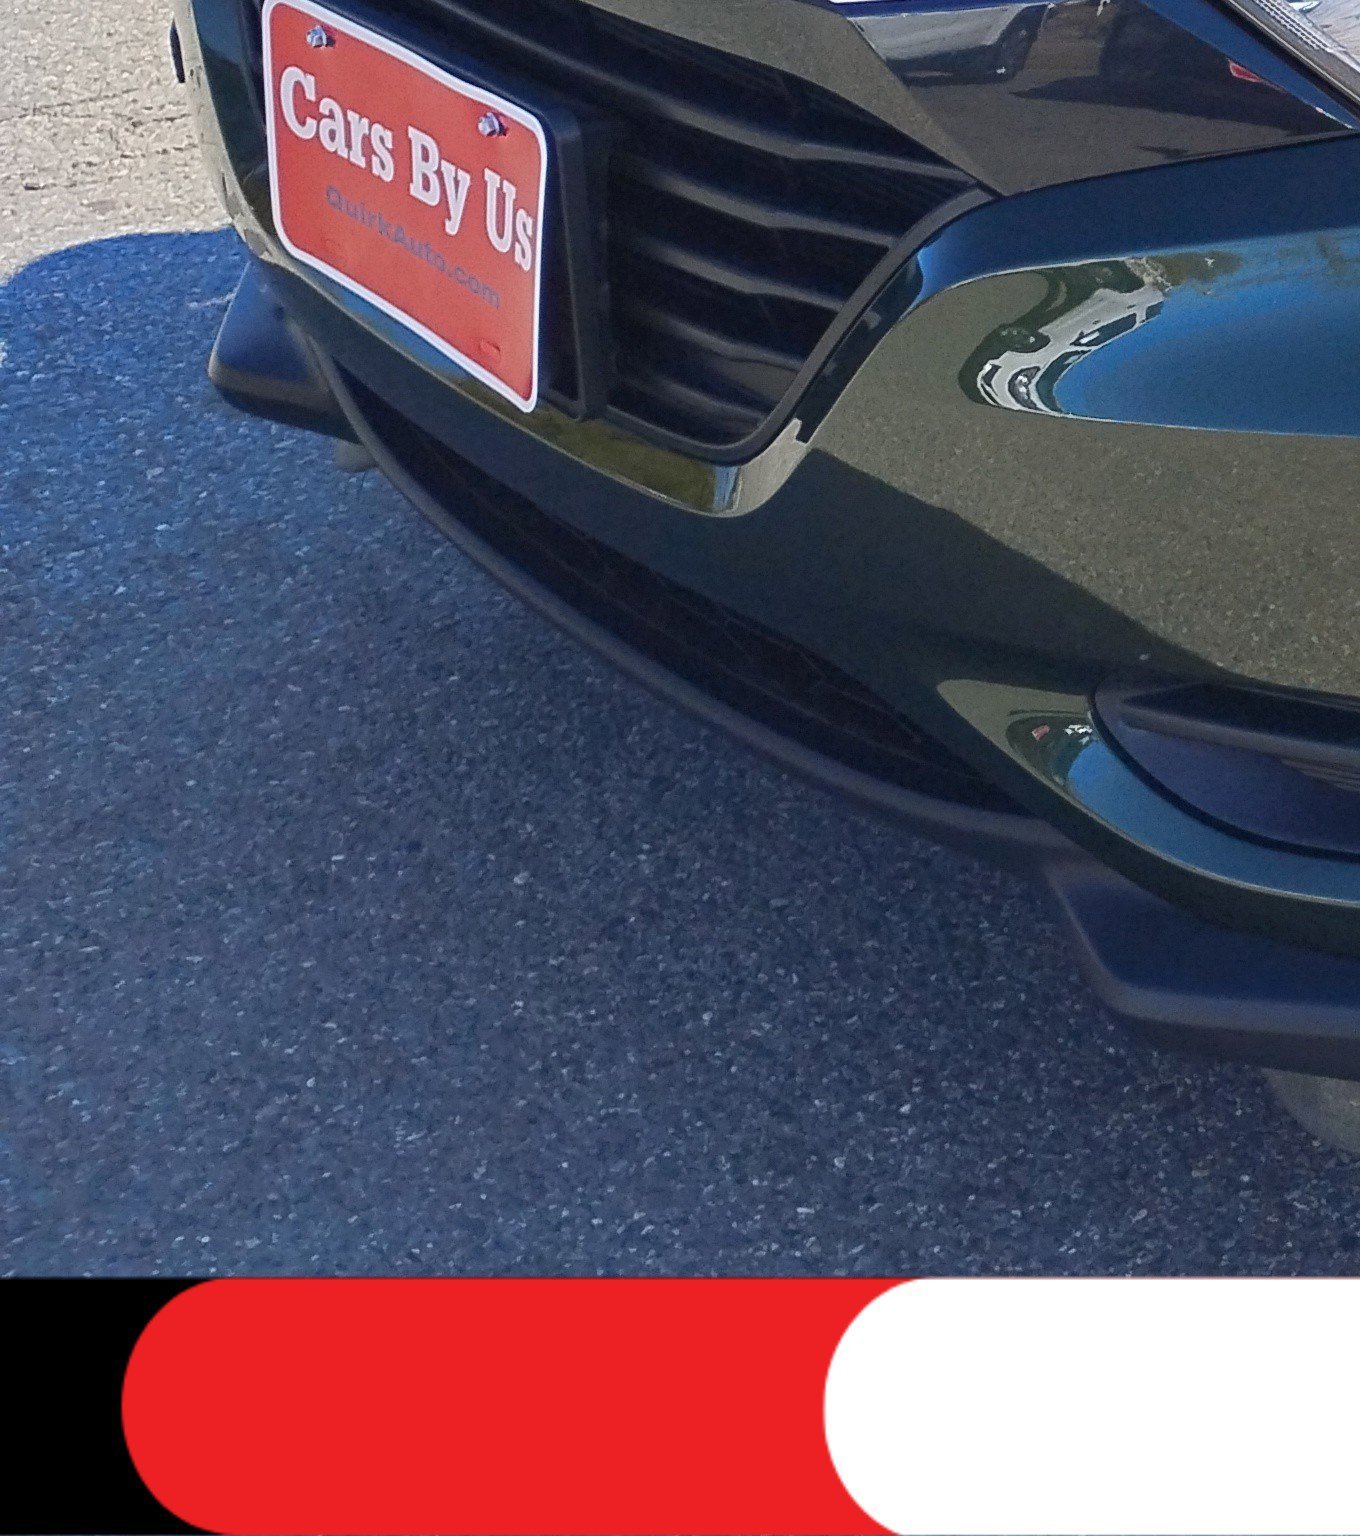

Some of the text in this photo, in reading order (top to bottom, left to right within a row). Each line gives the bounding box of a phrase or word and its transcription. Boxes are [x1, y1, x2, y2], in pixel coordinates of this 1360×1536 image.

[280, 66, 534, 272] Cars By Us
[327, 185, 501, 311] QuirkAuto.com
